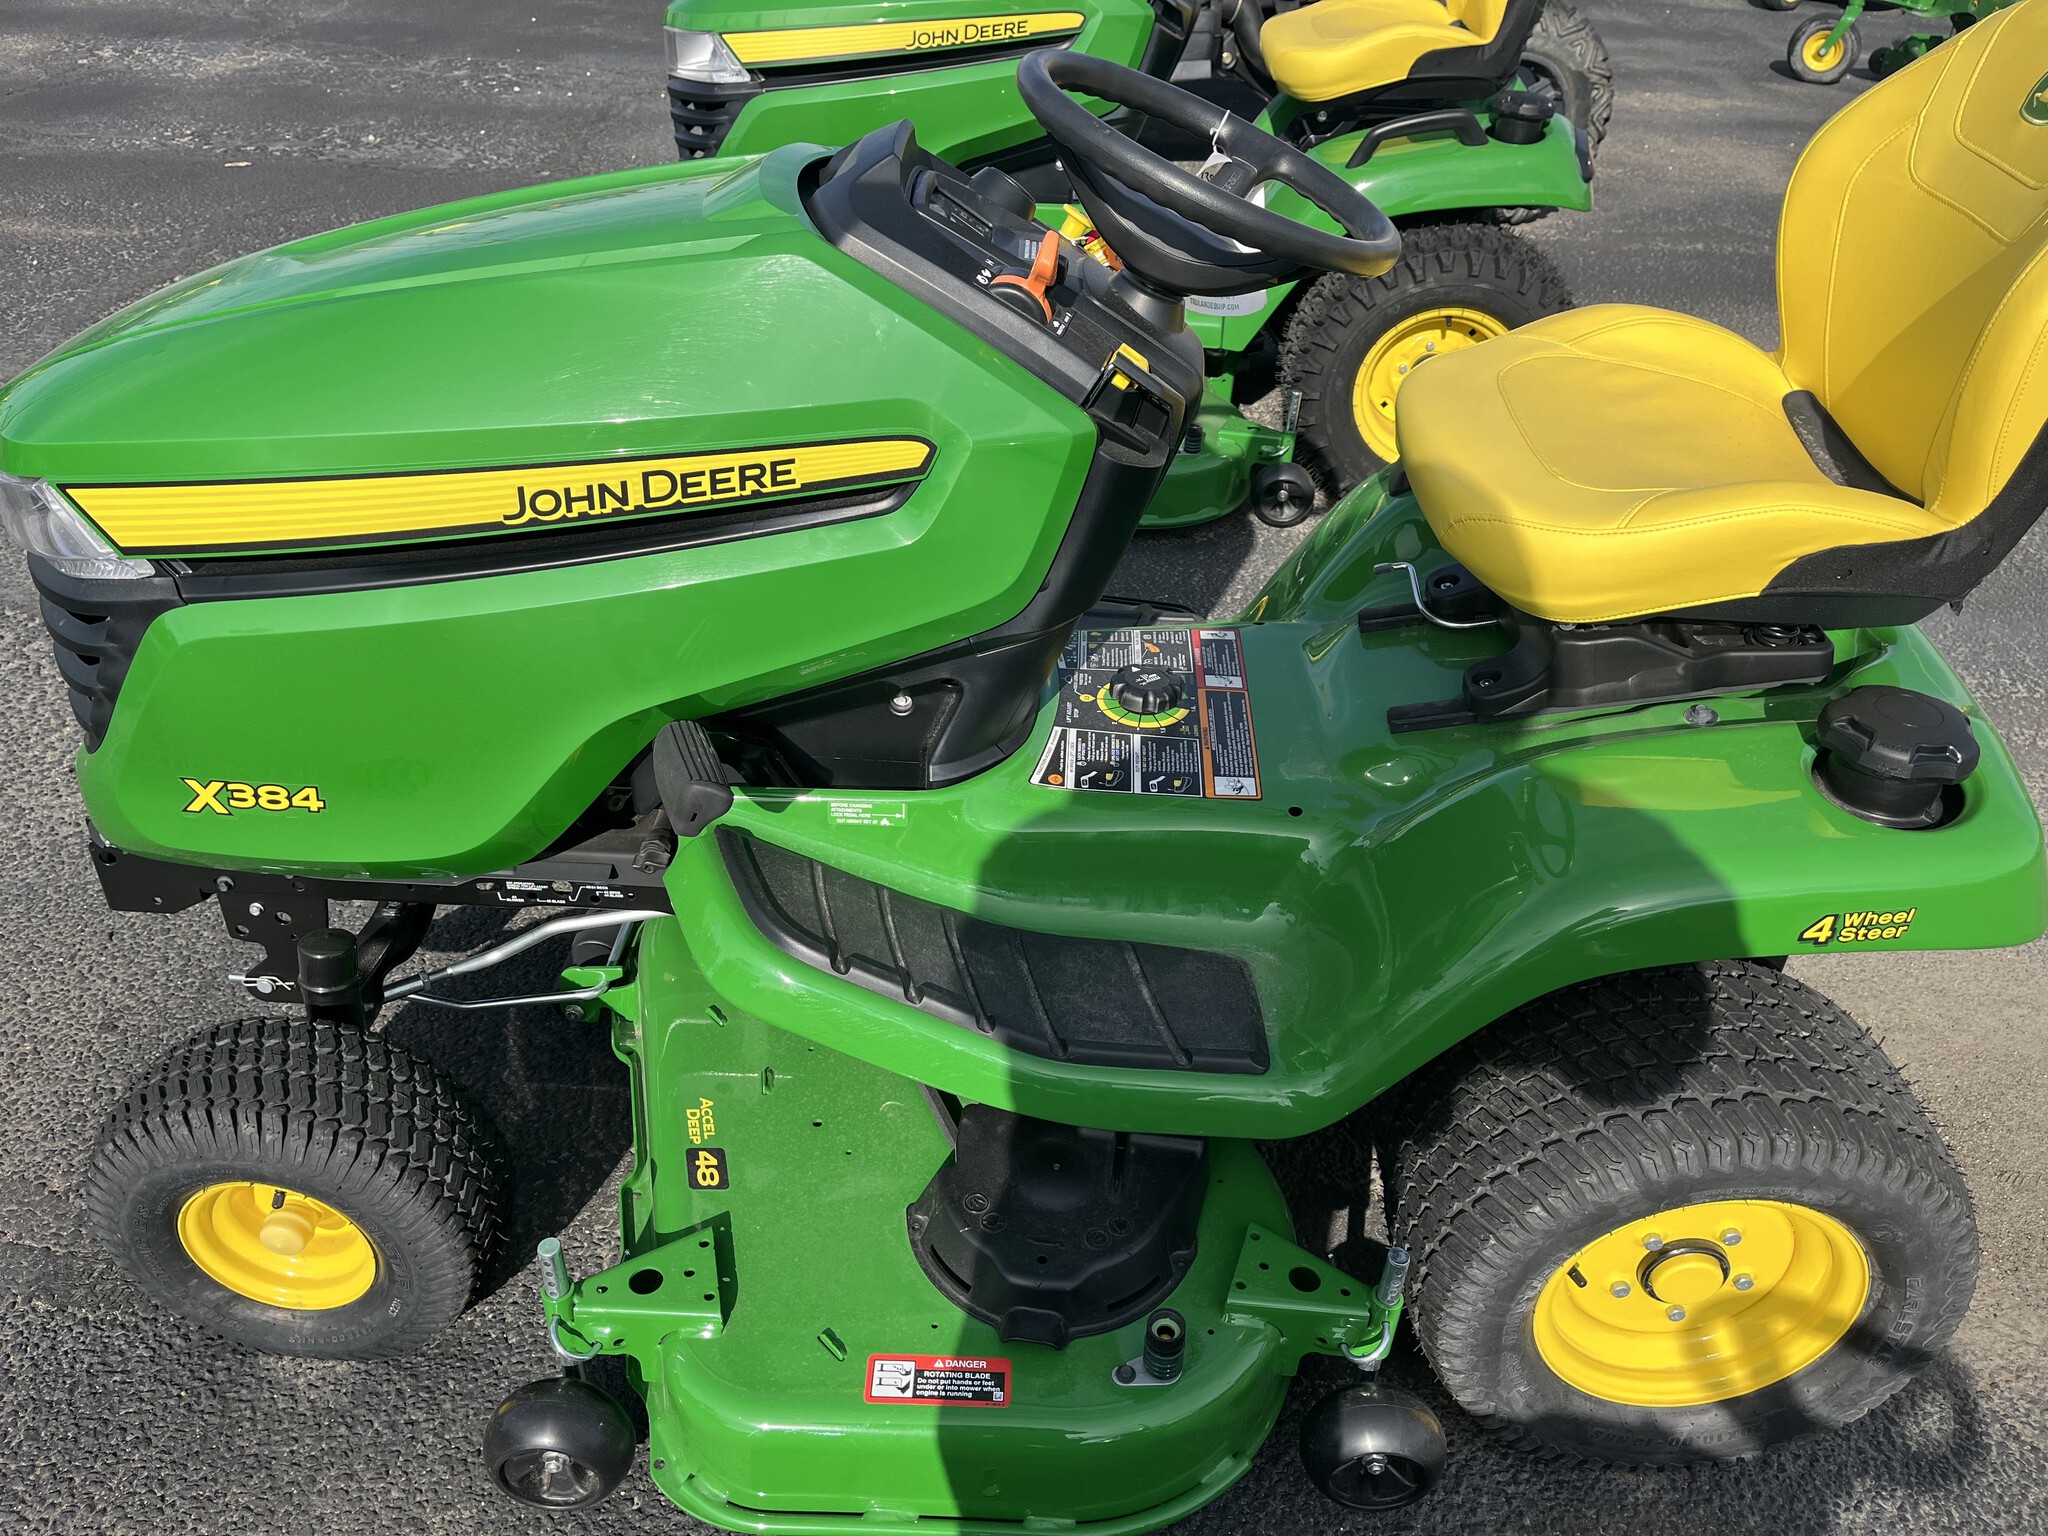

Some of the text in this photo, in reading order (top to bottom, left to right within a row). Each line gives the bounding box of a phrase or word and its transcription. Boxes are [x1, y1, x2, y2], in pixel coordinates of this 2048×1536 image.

[906, 20, 1028, 47] JOHN DEERE
[503, 458, 797, 520] JOHN DEERE
[178, 777, 326, 816] X384
[1797, 907, 1918, 946] 4 Wheel
[1837, 925, 1910, 943] Steer
[686, 1109, 702, 1145] DEEP
[699, 1097, 716, 1140] ACCEL
[695, 1151, 720, 1186] 48
[1867, 1276, 1922, 1368] CARLSTAR
[924, 1371, 963, 1379] ROTATING
[945, 1360, 987, 1369] DANGER
[1502, 1352, 1535, 1399] TURF
